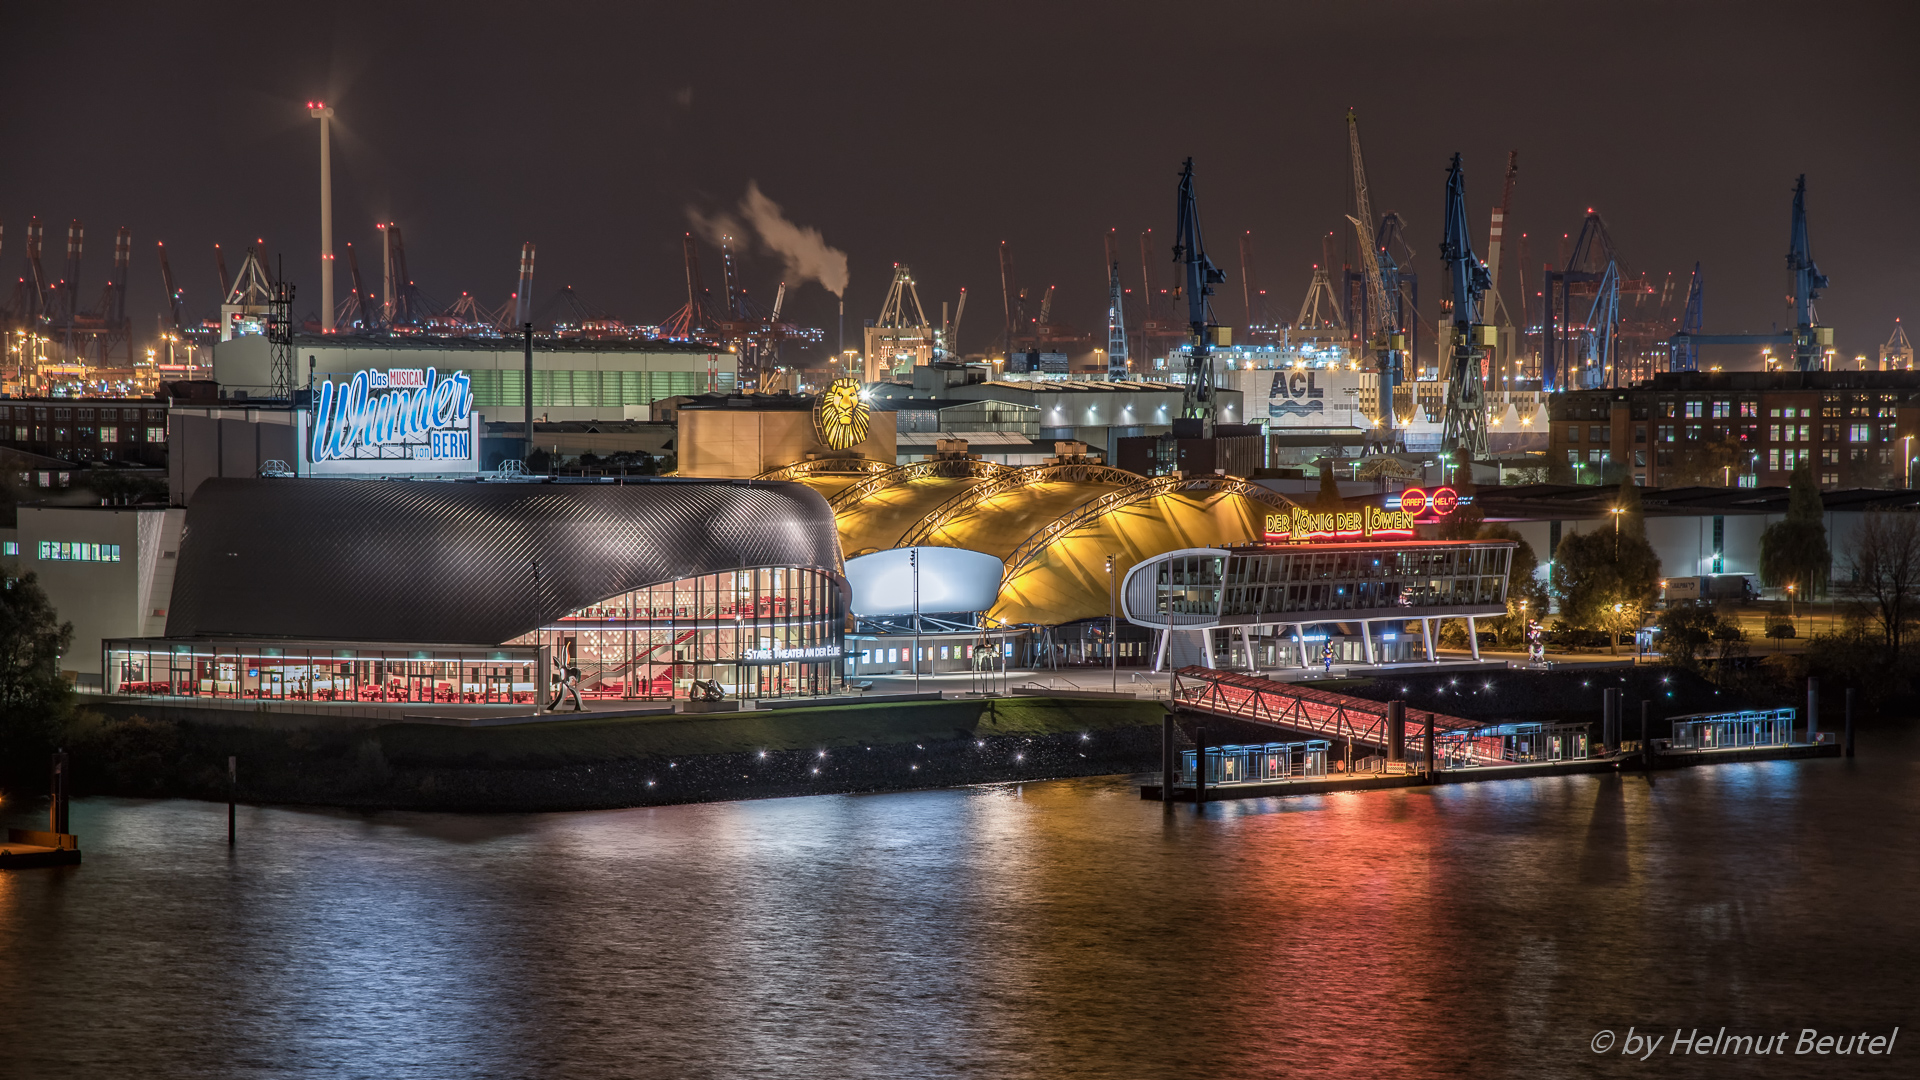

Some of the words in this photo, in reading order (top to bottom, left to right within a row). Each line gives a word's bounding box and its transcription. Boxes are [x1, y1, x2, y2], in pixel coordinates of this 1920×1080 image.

[371, 371, 387, 386] Das
[389, 371, 423, 386] MUSICAL
[1269, 371, 1324, 399] ACL
[313, 367, 473, 463] Wunder
[414, 447, 429, 458] von
[433, 433, 468, 458] BERN
[1266, 514, 1291, 533] DER
[1292, 506, 1334, 539] KÖNIG
[1336, 512, 1362, 531] DER
[1365, 505, 1414, 537] LÖWEN
